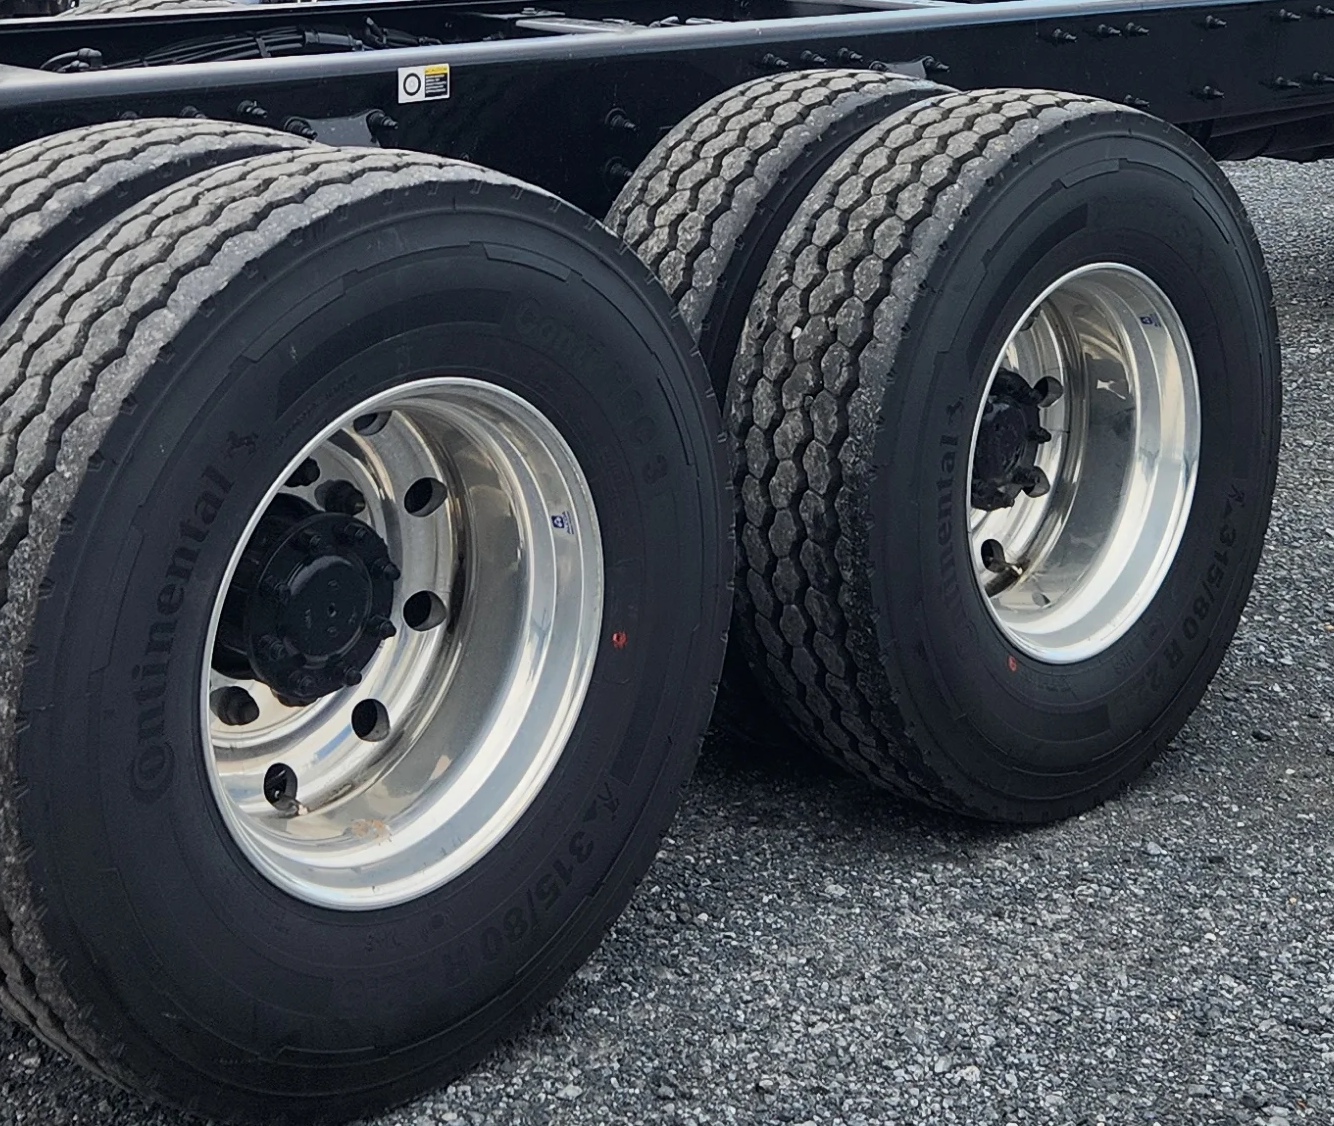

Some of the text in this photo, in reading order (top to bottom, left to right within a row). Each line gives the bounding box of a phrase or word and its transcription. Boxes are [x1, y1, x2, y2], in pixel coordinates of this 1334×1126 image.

[129, 464, 235, 805] Continental
[1182, 523, 1237, 645] 315/80
[479, 830, 596, 962] 315/80
